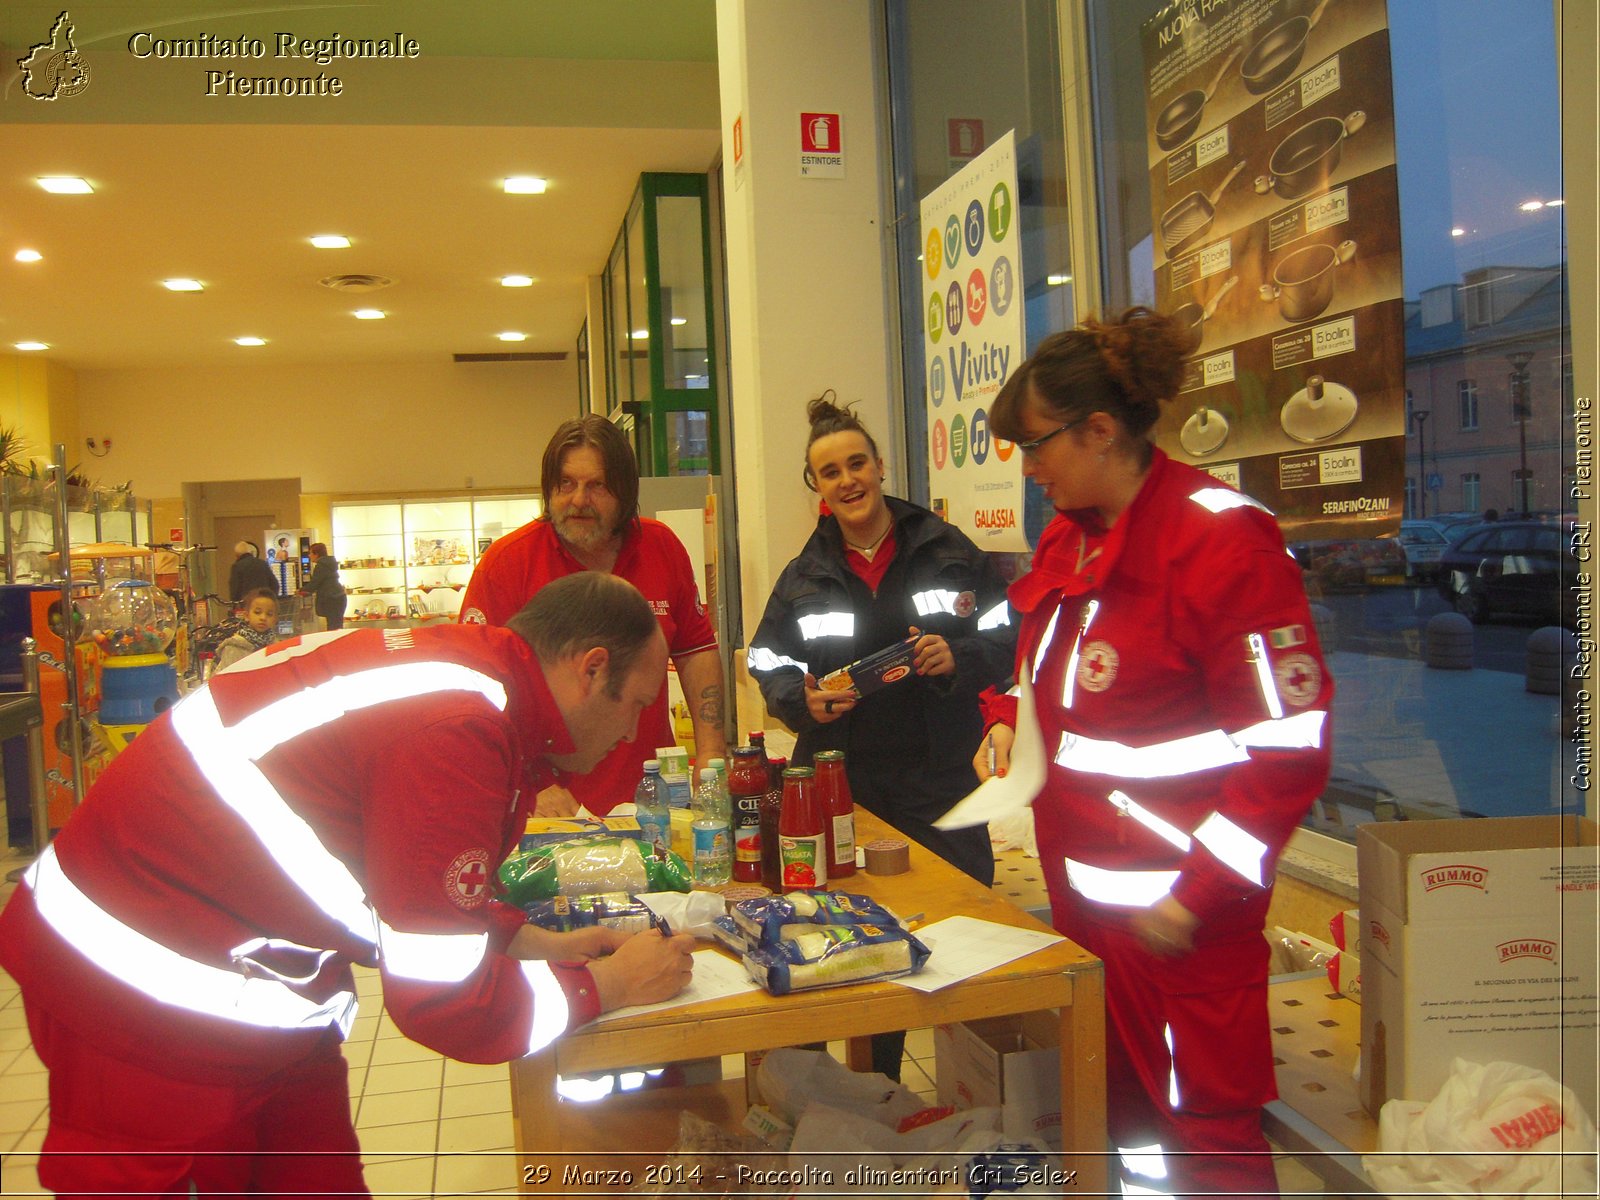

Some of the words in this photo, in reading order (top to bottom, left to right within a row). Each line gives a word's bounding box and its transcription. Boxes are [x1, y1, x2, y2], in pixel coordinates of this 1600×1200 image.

[1159, 5, 1200, 48] NUOVA
[1303, 79, 1314, 94] 20
[802, 156, 842, 165] ESTINTORE
[1307, 206, 1319, 220] 20
[1202, 254, 1210, 266] 20
[1316, 331, 1324, 344] 15
[1325, 327, 1350, 342] bollini
[949, 341, 1009, 402] Vivity
[1324, 458, 1330, 470] 5
[1331, 456, 1355, 469] bollini
[1322, 497, 1390, 514] SERAFINOZANI
[975, 509, 1016, 528] GALASSIA
[1427, 871, 1483, 885] RUMMO
[1501, 943, 1552, 958] RUMMO
